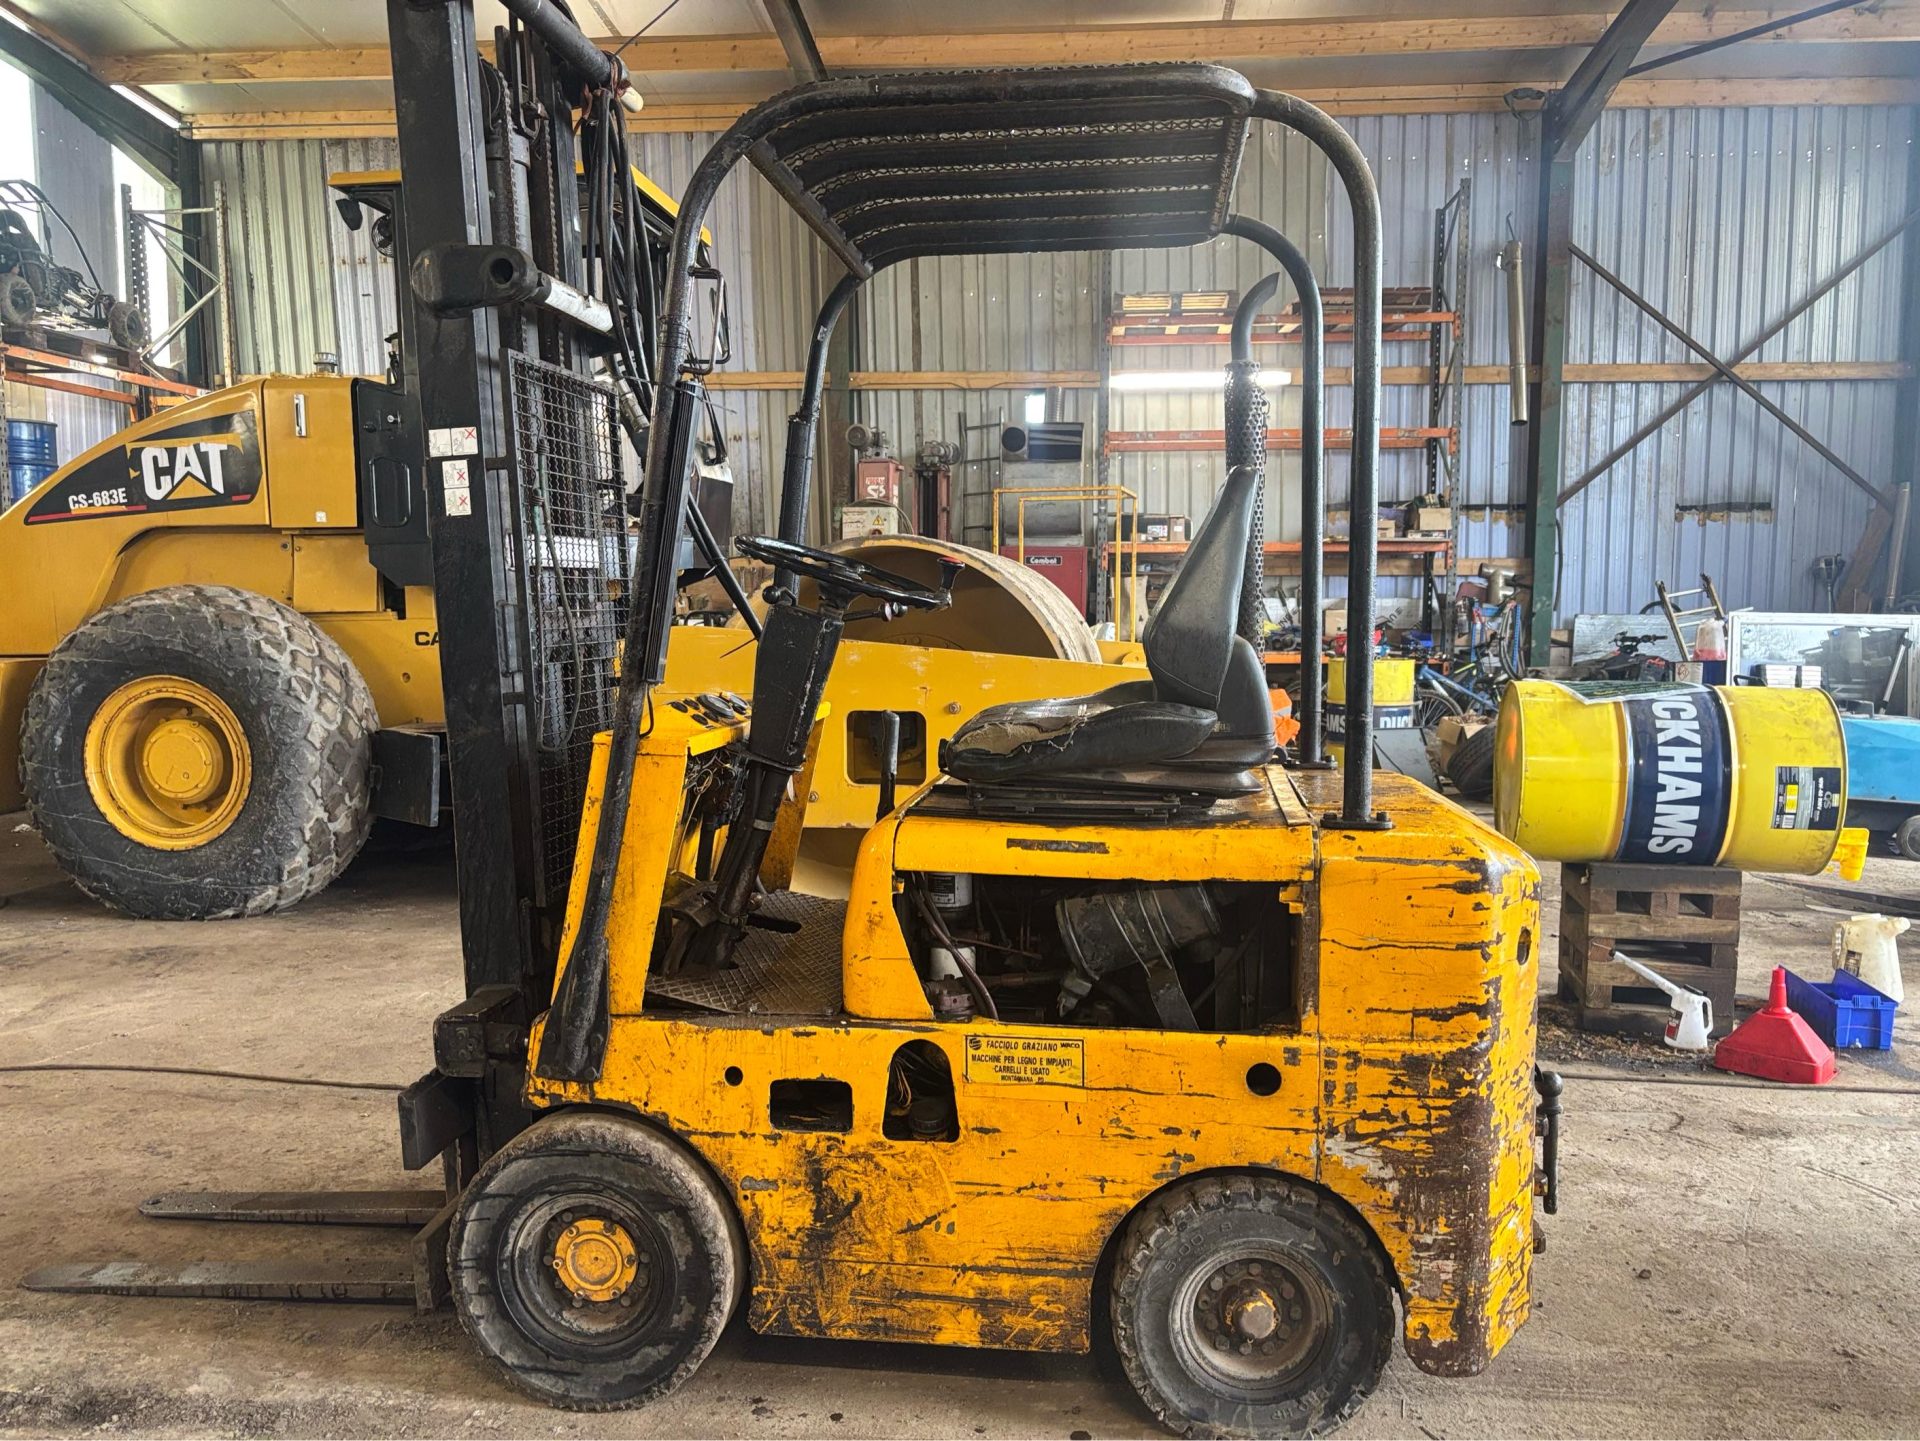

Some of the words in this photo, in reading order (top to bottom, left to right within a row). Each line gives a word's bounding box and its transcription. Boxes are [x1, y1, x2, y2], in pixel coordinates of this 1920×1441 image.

[140, 442, 228, 501] CAT
[68, 487, 128, 510] CS-683E
[1030, 556, 1057, 564] Combat
[986, 1040, 1019, 1050] FACCIOLO
[1022, 1041, 1058, 1052] GRAZIANO
[971, 1054, 1002, 1063] MACCHINE
[1004, 1055, 1015, 1064] PER
[1017, 1056, 1037, 1065] LEGNO
[1039, 1057, 1044, 1066] E
[1046, 1057, 1073, 1067] IMPIANTI
[994, 1064, 1022, 1074] CARRELLI
[1024, 1066, 1028, 1075] E
[1030, 1066, 1050, 1076] USATO
